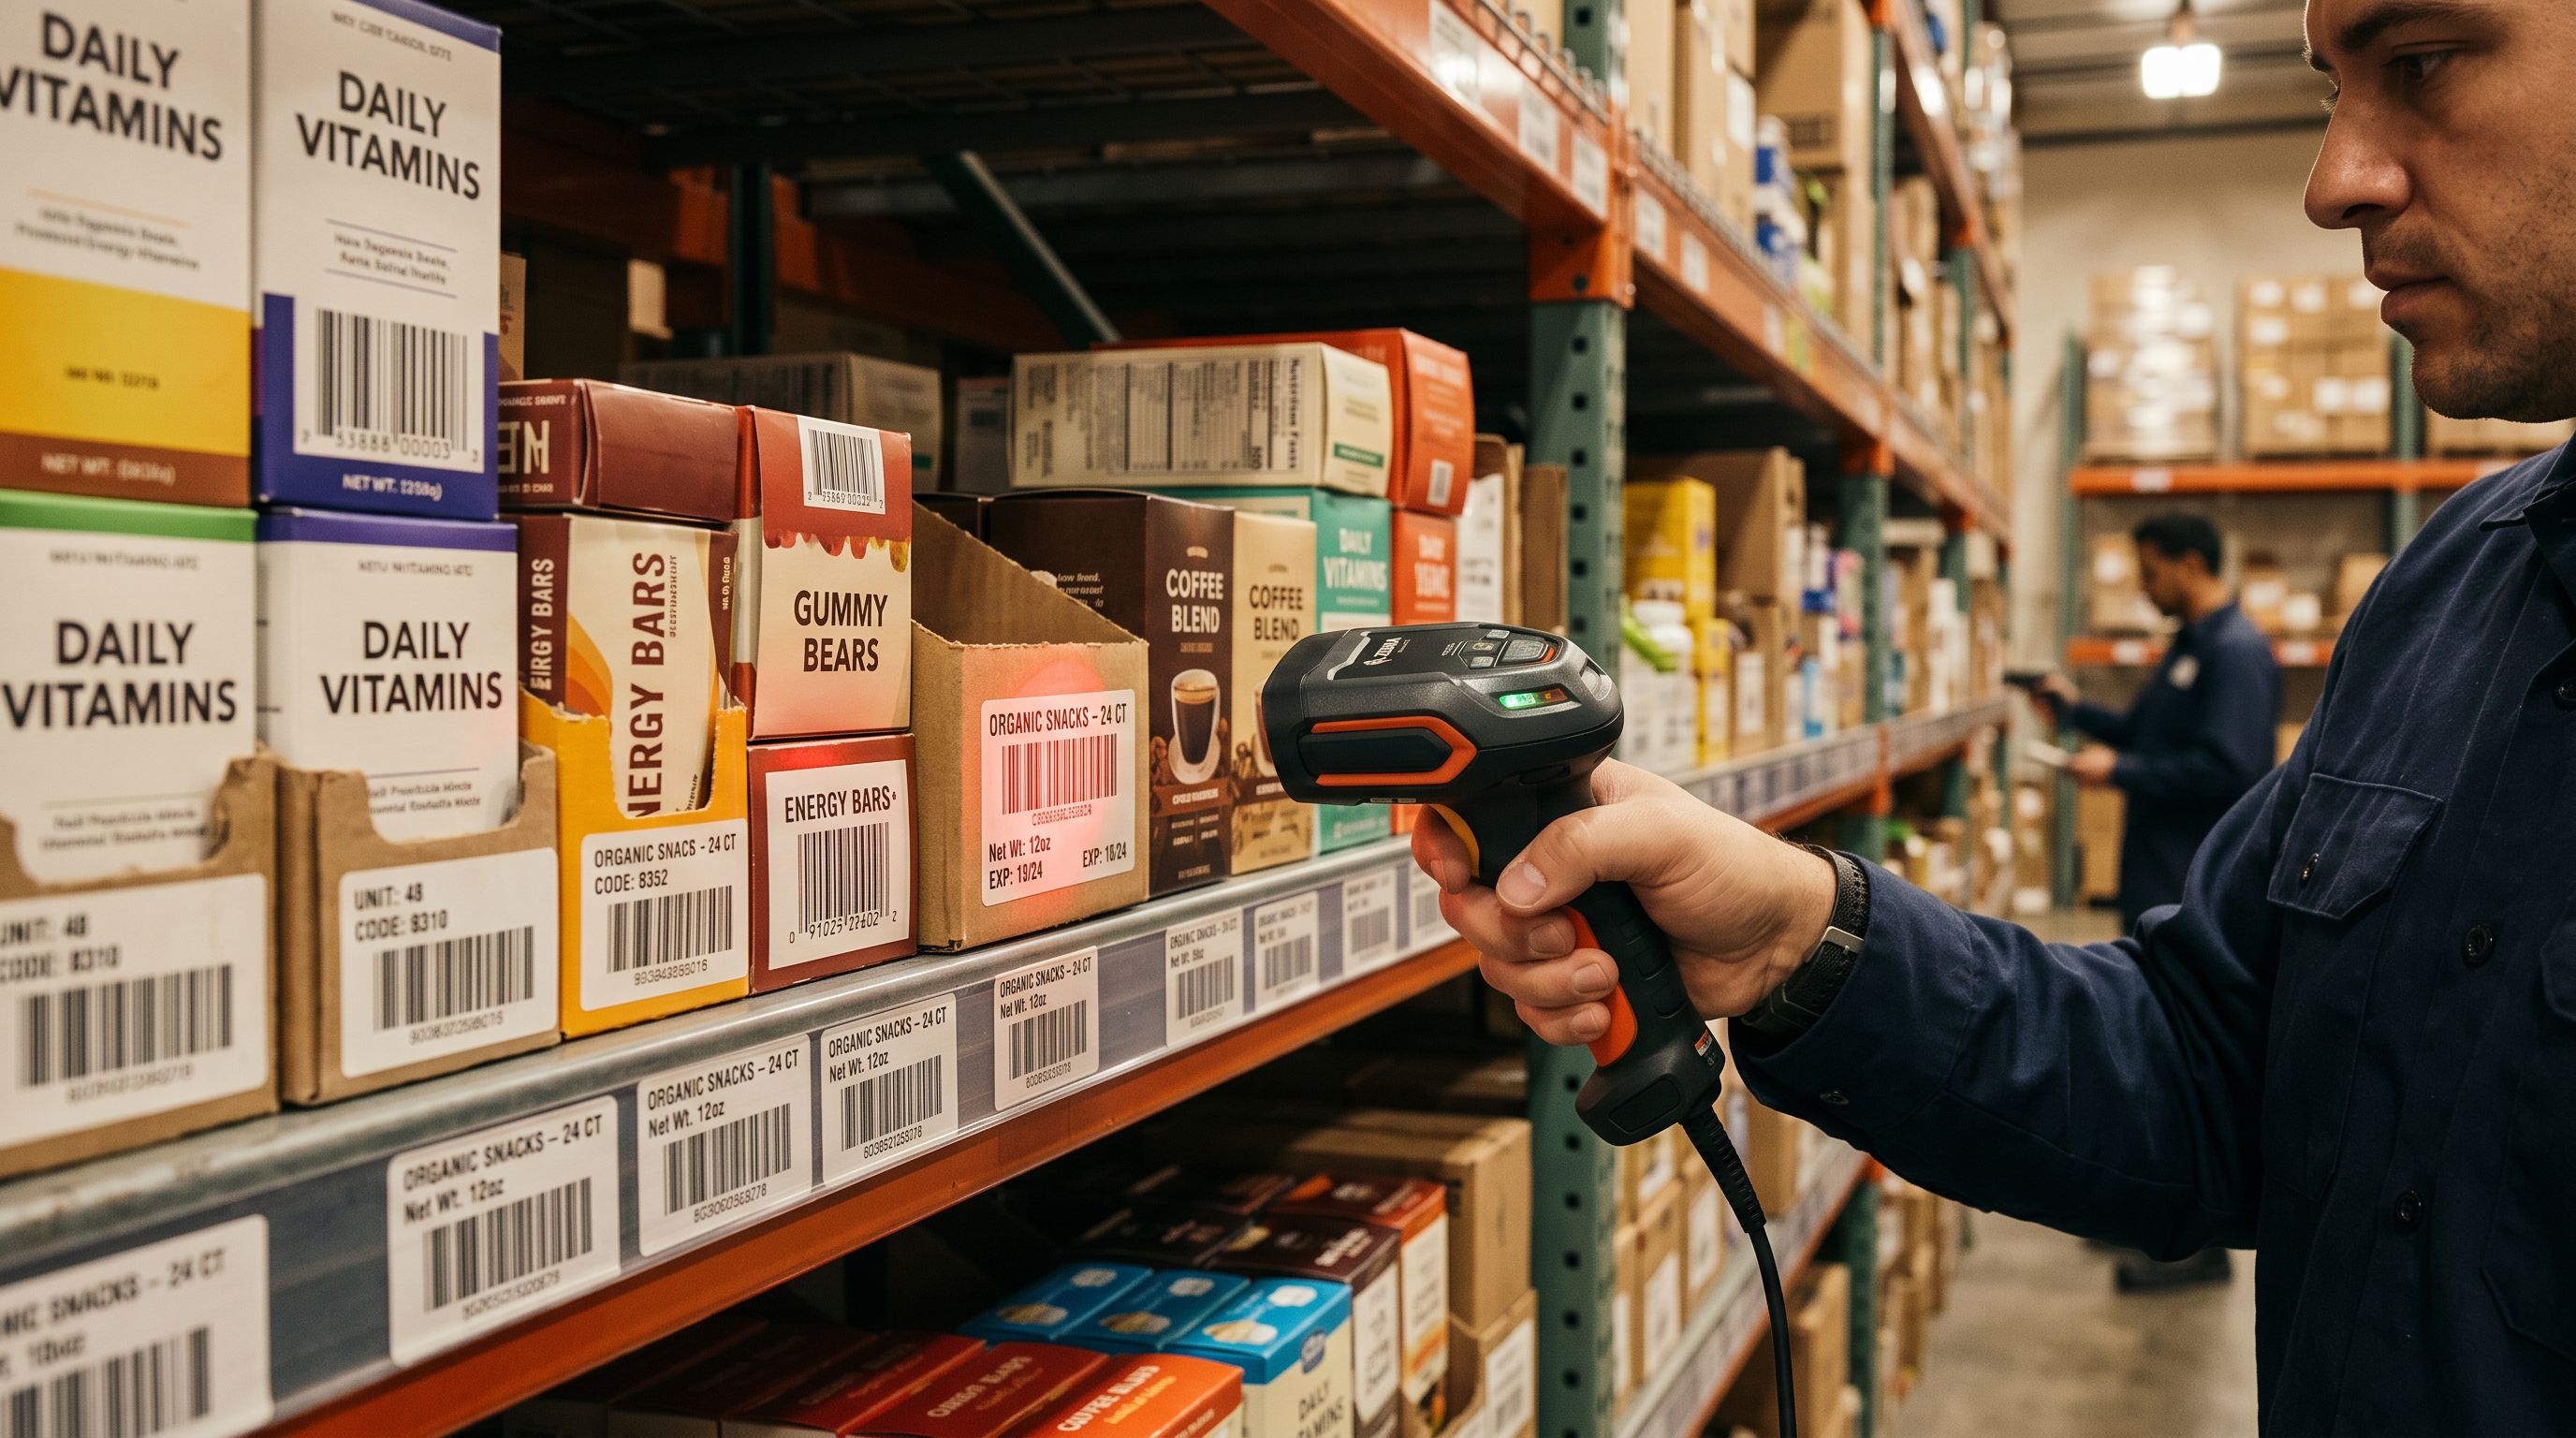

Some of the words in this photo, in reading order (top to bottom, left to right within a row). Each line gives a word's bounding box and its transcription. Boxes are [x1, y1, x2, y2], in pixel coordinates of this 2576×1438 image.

[41, 11, 182, 91] DAILY
[338, 69, 447, 139] DAILY
[295, 112, 482, 201] VITAMINS
[343, 474, 372, 491] NET
[531, 557, 555, 619] BARS
[1165, 567, 1225, 601] COFFEE
[1249, 584, 1305, 611] COFFEE
[631, 551, 666, 667] BARS
[794, 590, 888, 627] GUMMY
[1171, 604, 1222, 635] BLEND
[57, 620, 195, 668] DAILY
[362, 621, 471, 662] DAILY
[1253, 617, 1299, 641] BLEND
[803, 638, 879, 672] BEARS
[2, 679, 239, 730] VITAMINS
[319, 670, 504, 715] VITAMINS
[989, 710, 1043, 737] ORGANIC
[1046, 706, 1090, 731] SNACKS
[1101, 705, 1112, 726] 24
[1116, 703, 1127, 724] CT
[784, 790, 847, 823] ENERGY
[594, 844, 654, 869] ORGANIC
[709, 836, 721, 854] 24
[724, 833, 737, 851] CT
[988, 842, 1007, 863] Net
[1030, 835, 1051, 855] 12oz
[1083, 847, 1104, 869] EXP:
[594, 873, 636, 896] CODE:
[989, 867, 1014, 890] EXP:
[1017, 859, 1044, 885] 19/24
[354, 884, 401, 912] UNIT:
[405, 882, 424, 902] 48
[355, 915, 405, 943] CODE:
[1000, 972, 1034, 999] ORGANIC
[1036, 964, 1065, 988] SNACKS
[1073, 960, 1081, 976] 24
[1014, 997, 1027, 1016] Wt.
[1030, 993, 1046, 1011] 12oz
[828, 1028, 873, 1059] ORGANIC
[875, 1016, 912, 1044] SNACKS
[922, 1010, 934, 1029] 24
[935, 1005, 947, 1026] CT
[648, 1077, 705, 1111] ORGANIC
[708, 1061, 755, 1093] SNACKS
[768, 1053, 783, 1075] 24
[784, 1049, 799, 1070] CT
[829, 1062, 846, 1084] Net
[847, 1057, 865, 1078] Wt.
[867, 1051, 889, 1071] 12oz
[648, 1116, 670, 1138] Net
[673, 1108, 694, 1131] Wt.
[697, 1101, 725, 1123] 12oz
[403, 1149, 479, 1193] ORGANIC
[483, 1131, 545, 1168] SNACKS
[563, 1120, 580, 1145] 24
[583, 1114, 603, 1138] CT
[403, 1197, 432, 1225] Net
[469, 1176, 505, 1203] 12oz
